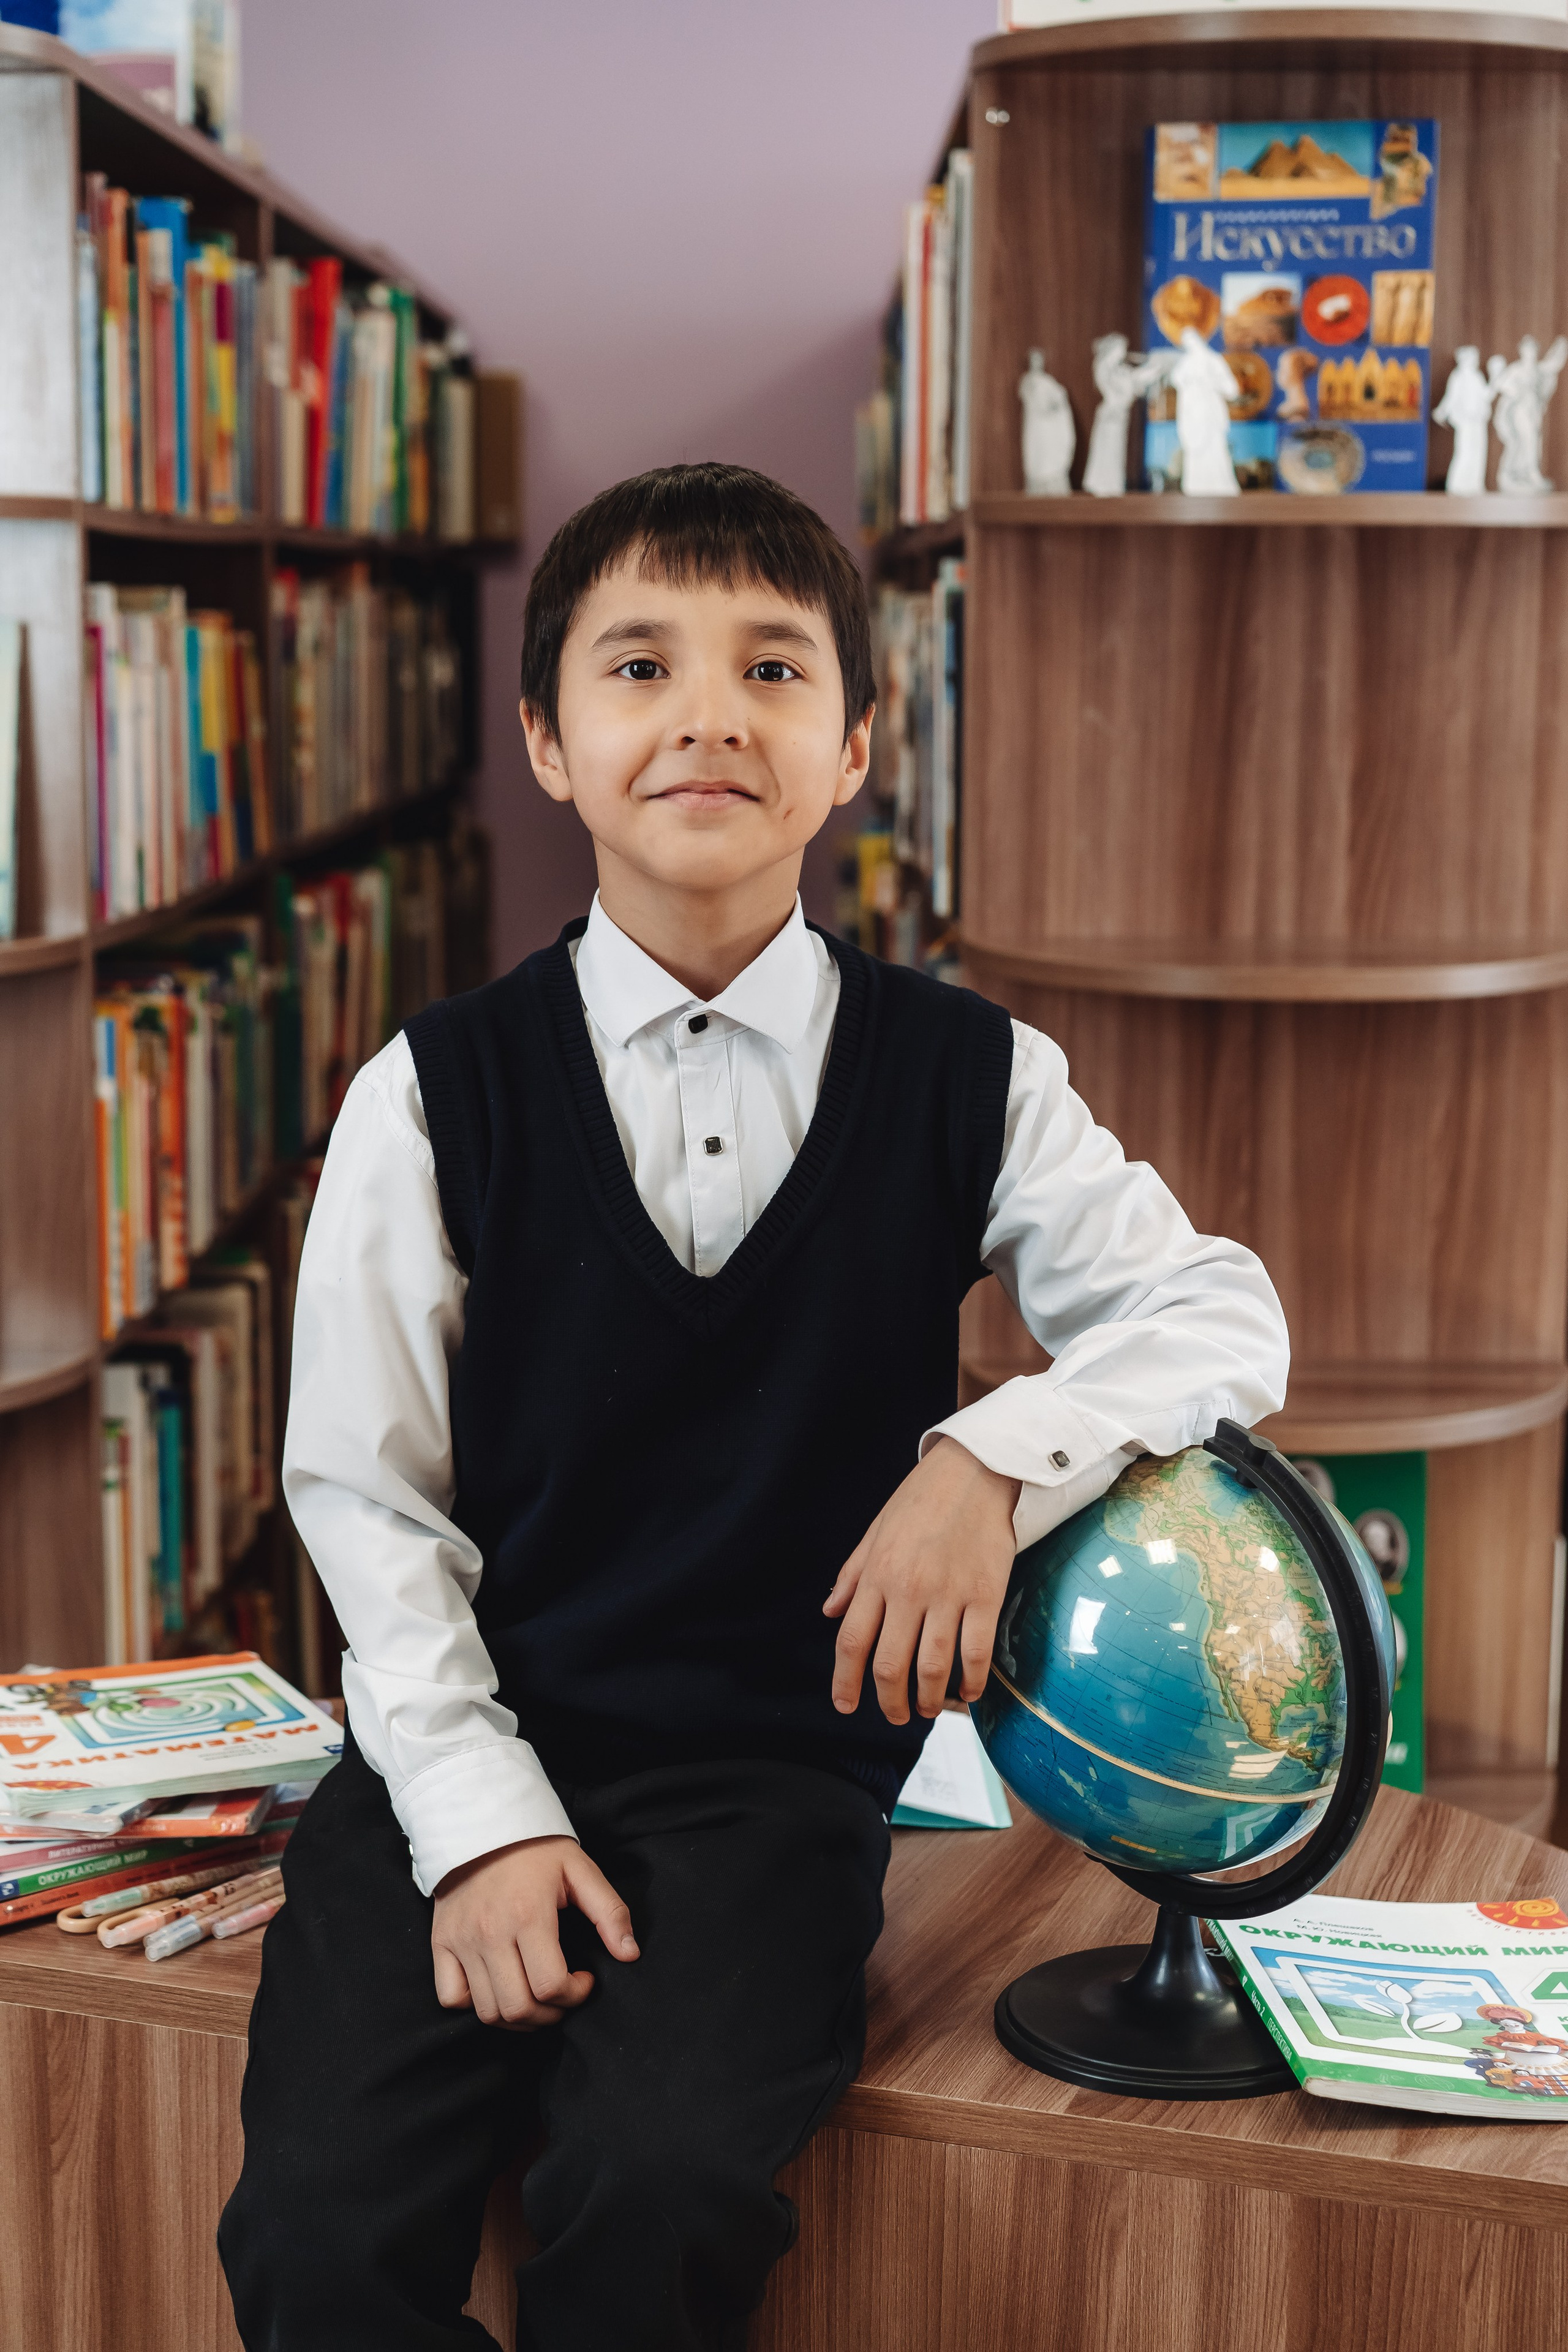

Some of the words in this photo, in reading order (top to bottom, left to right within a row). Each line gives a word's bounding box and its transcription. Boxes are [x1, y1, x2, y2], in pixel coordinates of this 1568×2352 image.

[1173, 211, 1417, 271] Искусство
[12, 1724, 319, 1770] МАТЕМАТИКА
[38, 1855, 121, 1885] ОКРУЖАЮЩИЙ
[1238, 1924, 1489, 1956] ОКРУЖАЮЩИЙ
[1501, 1945, 1568, 1956] МИР
[1267, 2017, 1292, 2062] ПЕРСПЕКТИВА
